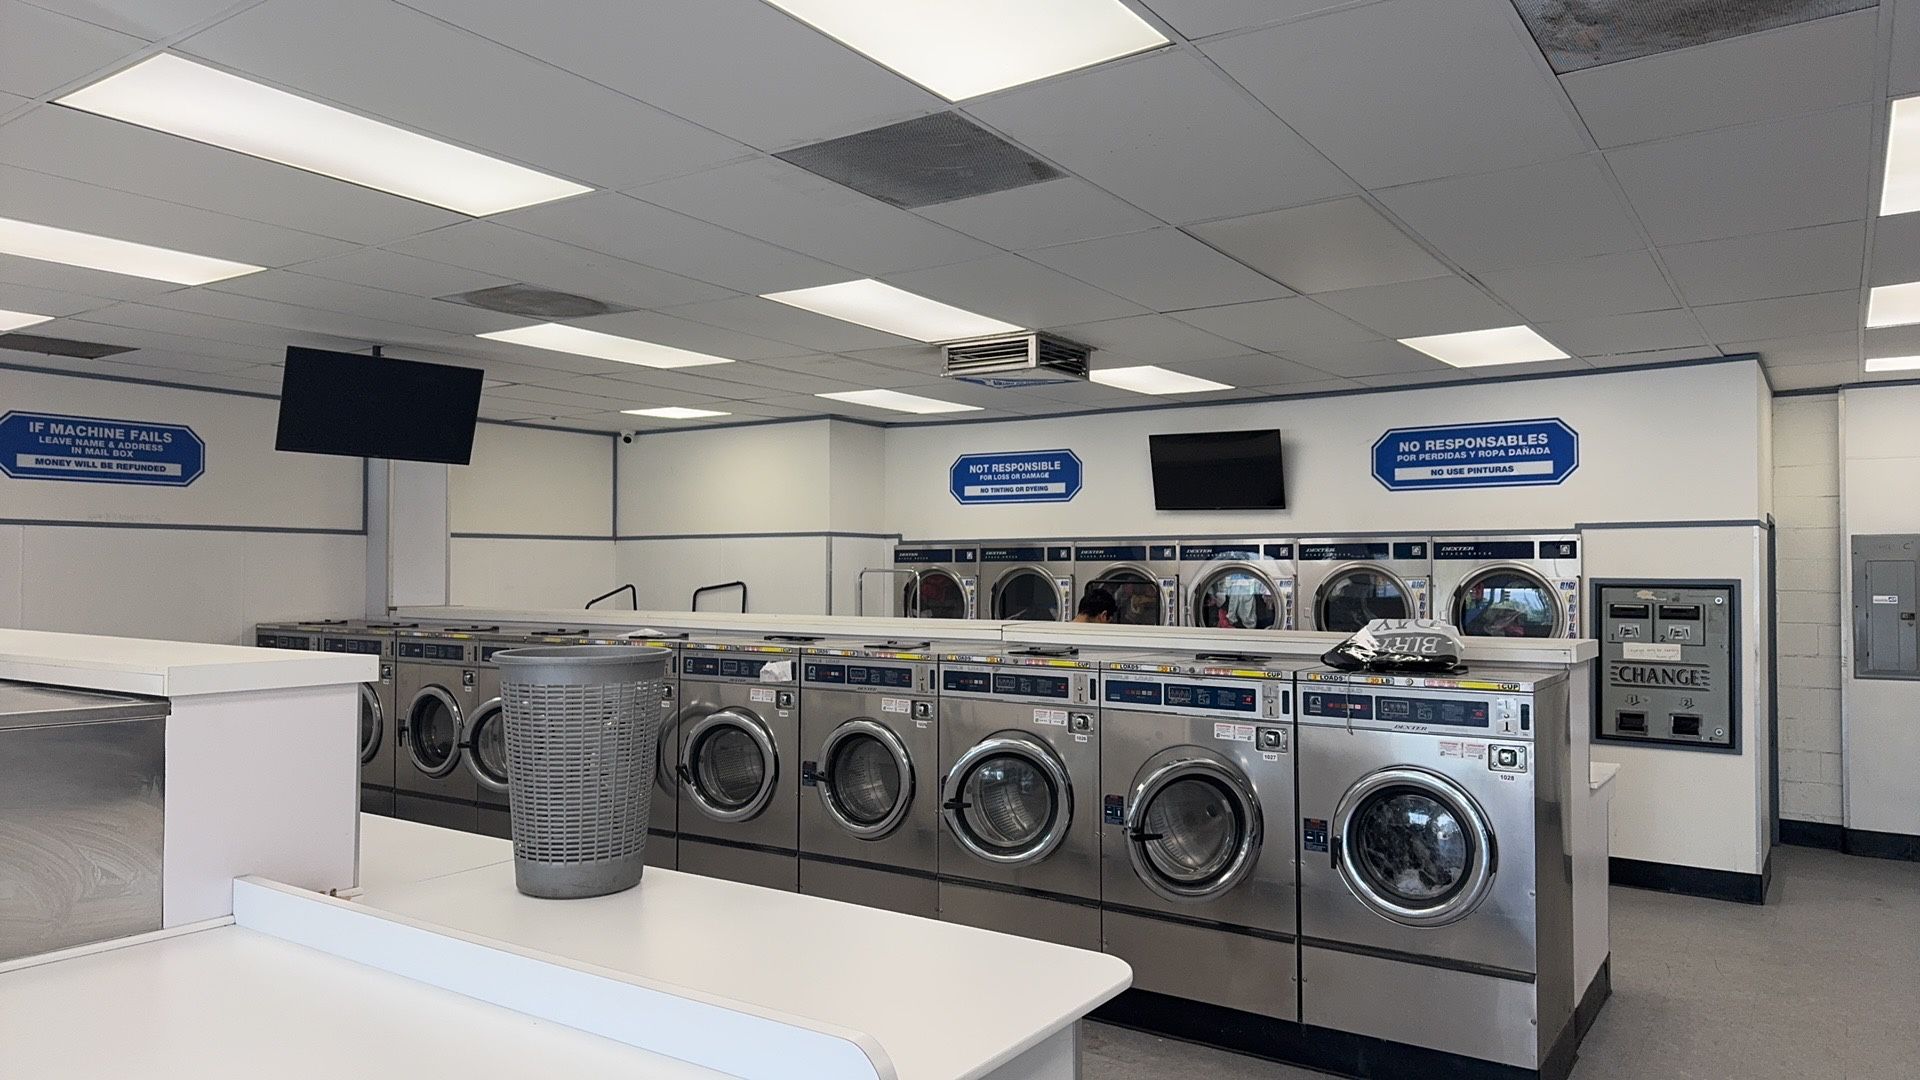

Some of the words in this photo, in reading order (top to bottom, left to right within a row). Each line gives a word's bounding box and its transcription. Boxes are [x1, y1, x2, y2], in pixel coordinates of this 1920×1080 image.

[29, 422, 44, 432] IF
[50, 424, 124, 439] MACHINE
[130, 430, 172, 443] FAILS
[39, 436, 72, 445] LEAVE
[76, 438, 105, 447] NAME
[118, 442, 164, 452] ADDRESS
[1399, 440, 1420, 453] NO
[1425, 433, 1548, 450] RESPONSABLES
[85, 448, 109, 456] MAIL
[1397, 454, 1416, 462] POR
[1419, 452, 1466, 461] PERDIDAS
[1478, 449, 1505, 458] ROPA
[1508, 446, 1551, 456] DAÑADA
[35, 458, 71, 466] MONEY
[74, 460, 98, 468] WILL
[116, 462, 166, 472] REFUNDED
[969, 464, 989, 474] NOT
[992, 461, 1061, 472] RESPONSIBLE
[1467, 466, 1514, 474] PINTURAS
[1375, 637, 1442, 654] BIRT
[1618, 666, 1700, 687] CHANGE
